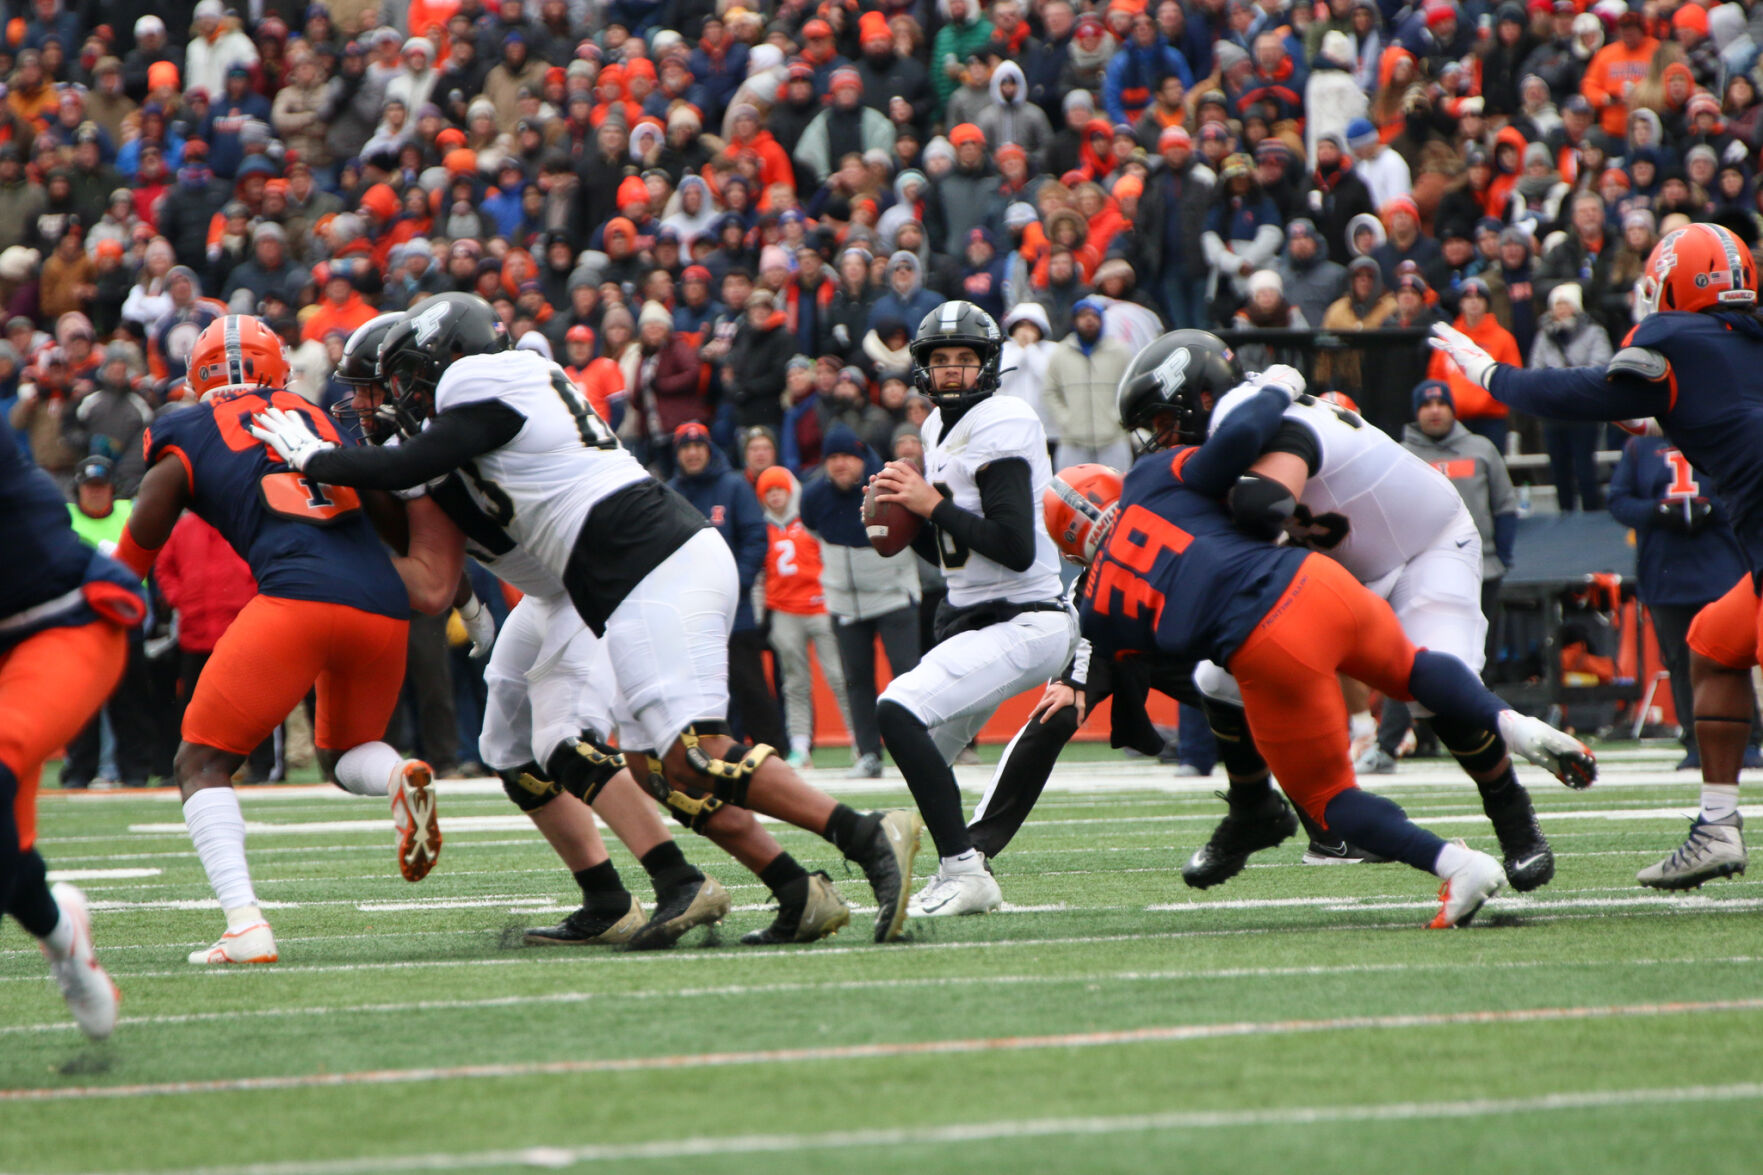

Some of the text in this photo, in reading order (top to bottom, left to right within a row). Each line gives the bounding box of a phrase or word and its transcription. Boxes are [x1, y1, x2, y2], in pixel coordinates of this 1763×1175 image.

[411, 301, 450, 347] P
[1154, 347, 1192, 399] P
[774, 539, 798, 576] 2
[1093, 503, 1195, 633] 39
